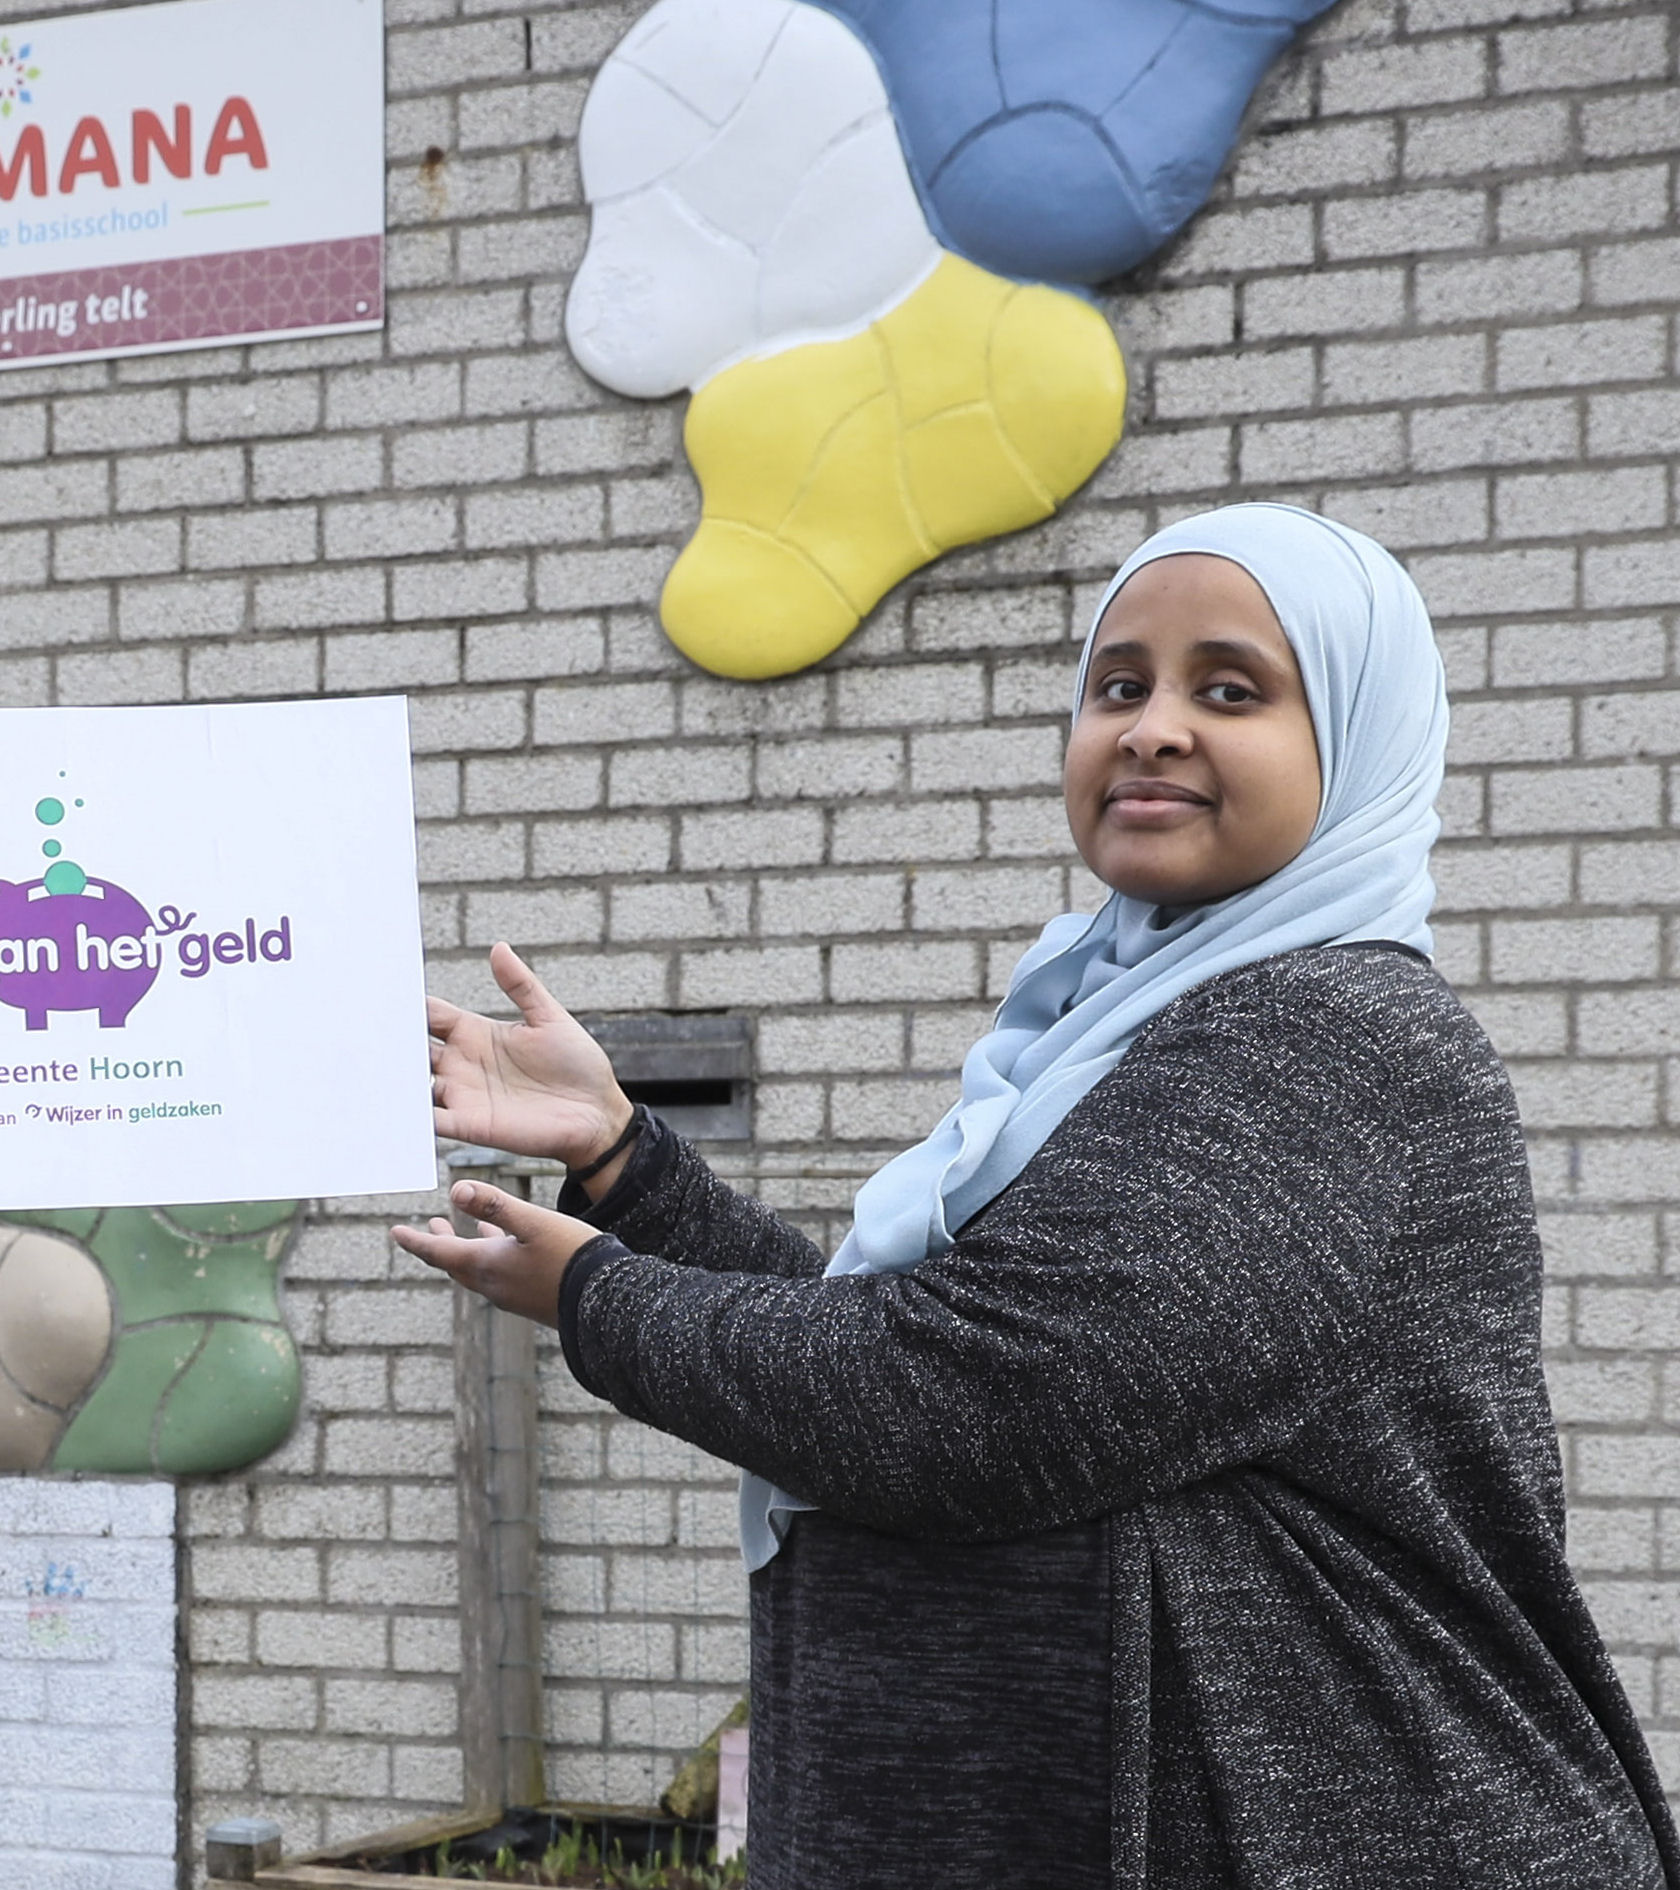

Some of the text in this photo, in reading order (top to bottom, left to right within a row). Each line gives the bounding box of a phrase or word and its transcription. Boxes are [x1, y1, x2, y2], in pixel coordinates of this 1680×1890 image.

[17, 202, 169, 246] basisschool
[85, 285, 149, 325] telt
[75, 921, 162, 971] het
[178, 916, 292, 978] geld
[90, 1056, 183, 1081] Hoorn
[46, 1105, 101, 1126] Wijzer
[107, 1104, 123, 1120] in
[128, 1100, 223, 1123] geldzaken
